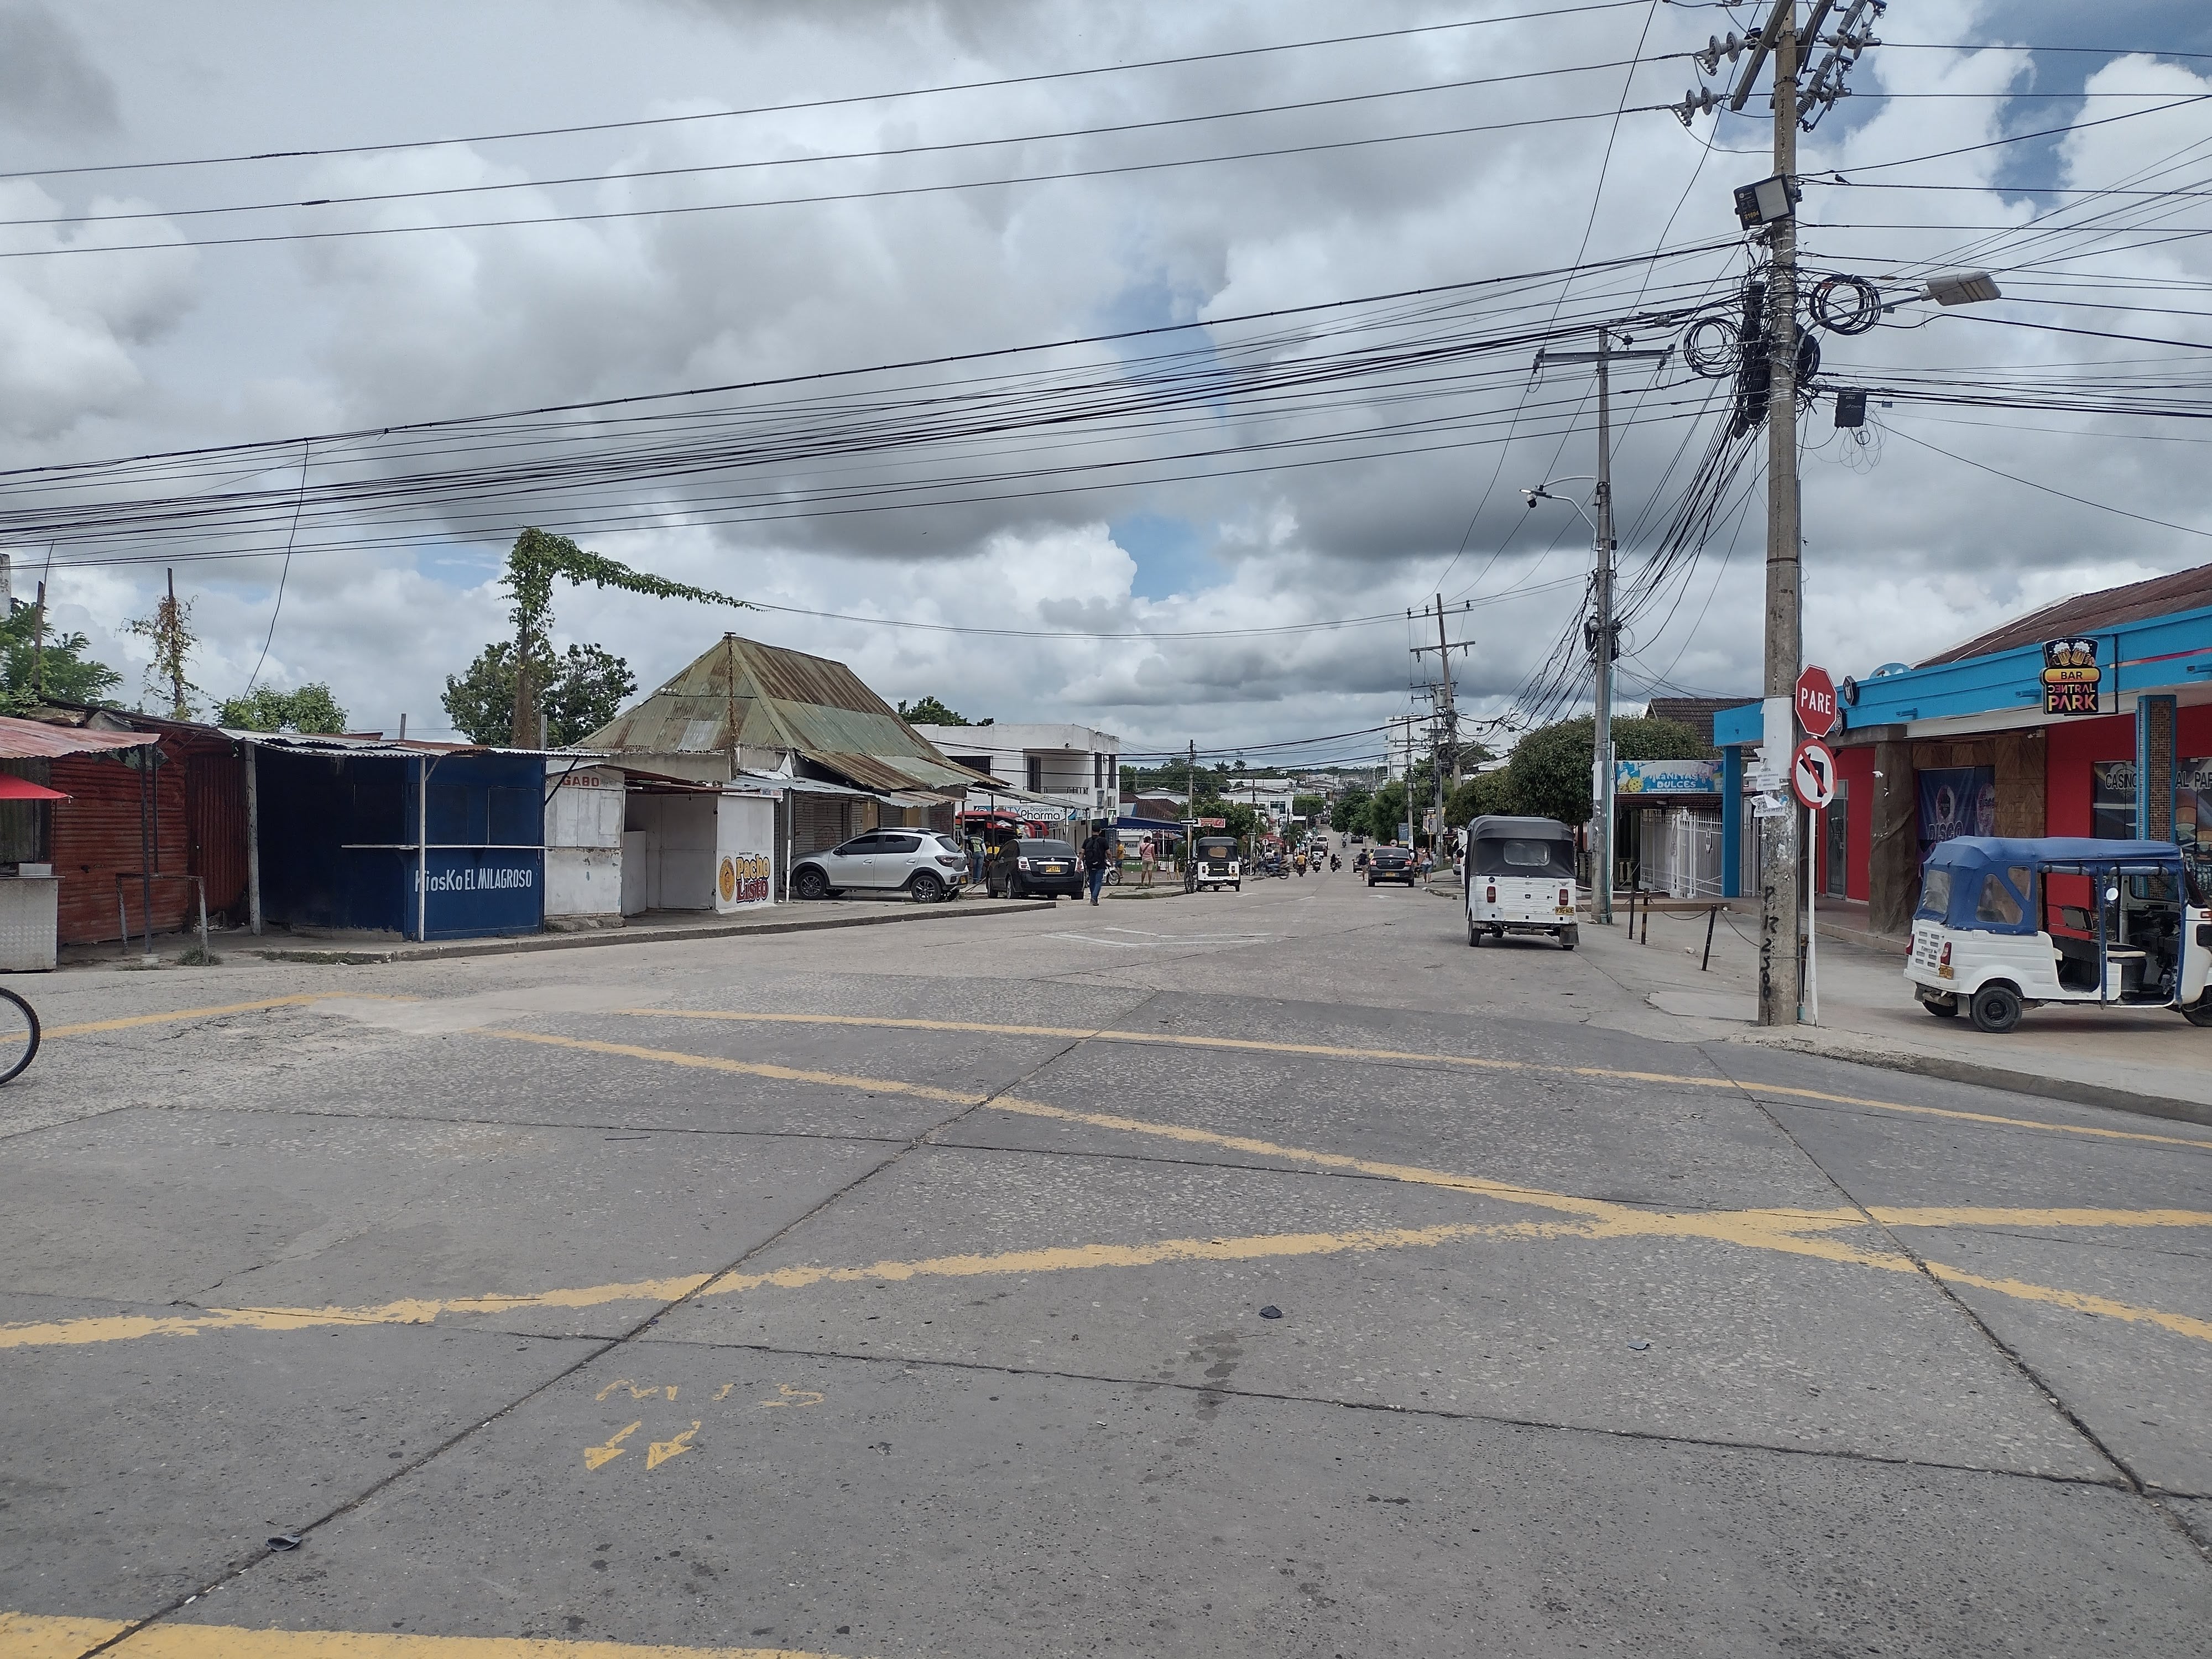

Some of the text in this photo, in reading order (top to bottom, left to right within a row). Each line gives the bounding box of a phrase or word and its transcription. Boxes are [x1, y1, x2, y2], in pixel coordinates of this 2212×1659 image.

[2060, 671, 2083, 680] BAR
[1801, 687, 1832, 715] PARE
[2048, 695, 2096, 711] PARK
[562, 775, 599, 786] GABO
[1021, 810, 1060, 820] Pharma
[736, 854, 770, 880] Pacho
[465, 869, 476, 890] EL
[477, 868, 532, 889] MILAGROSO
[736, 879, 769, 904] Listo
